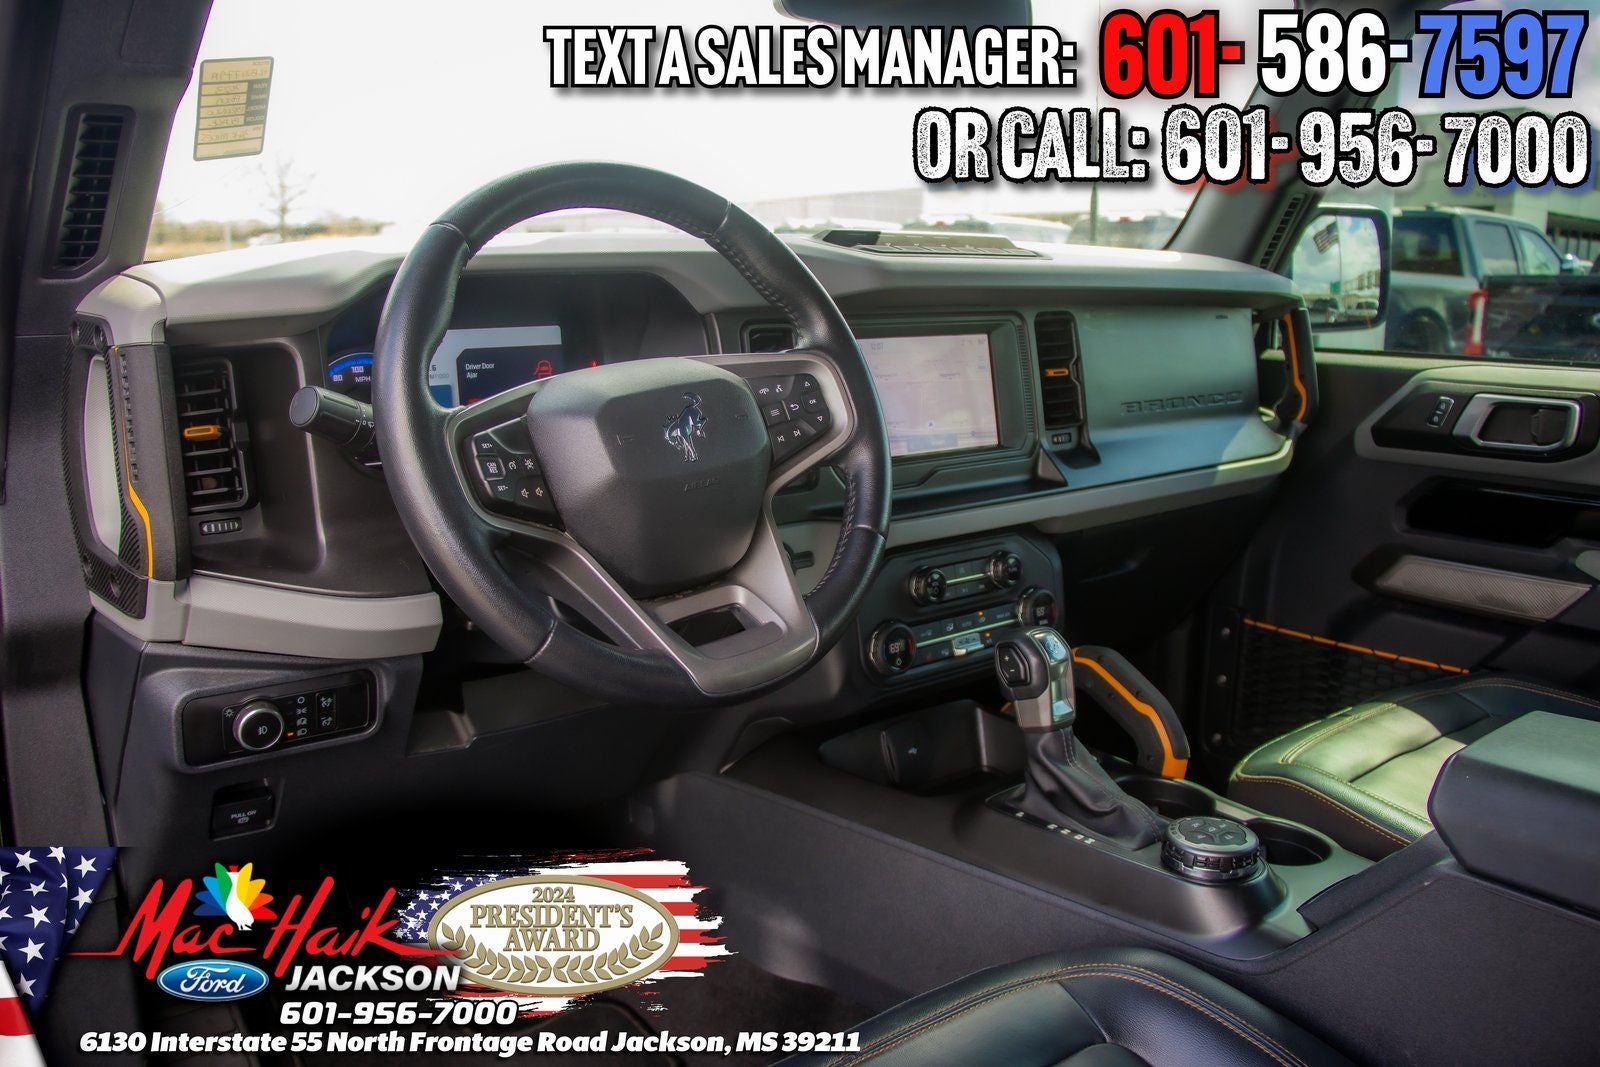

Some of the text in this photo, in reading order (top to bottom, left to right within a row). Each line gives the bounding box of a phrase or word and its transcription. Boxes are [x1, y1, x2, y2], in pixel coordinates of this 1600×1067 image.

[465, 362, 495, 371] Driver Door
[1120, 390, 1244, 416] BRONCO
